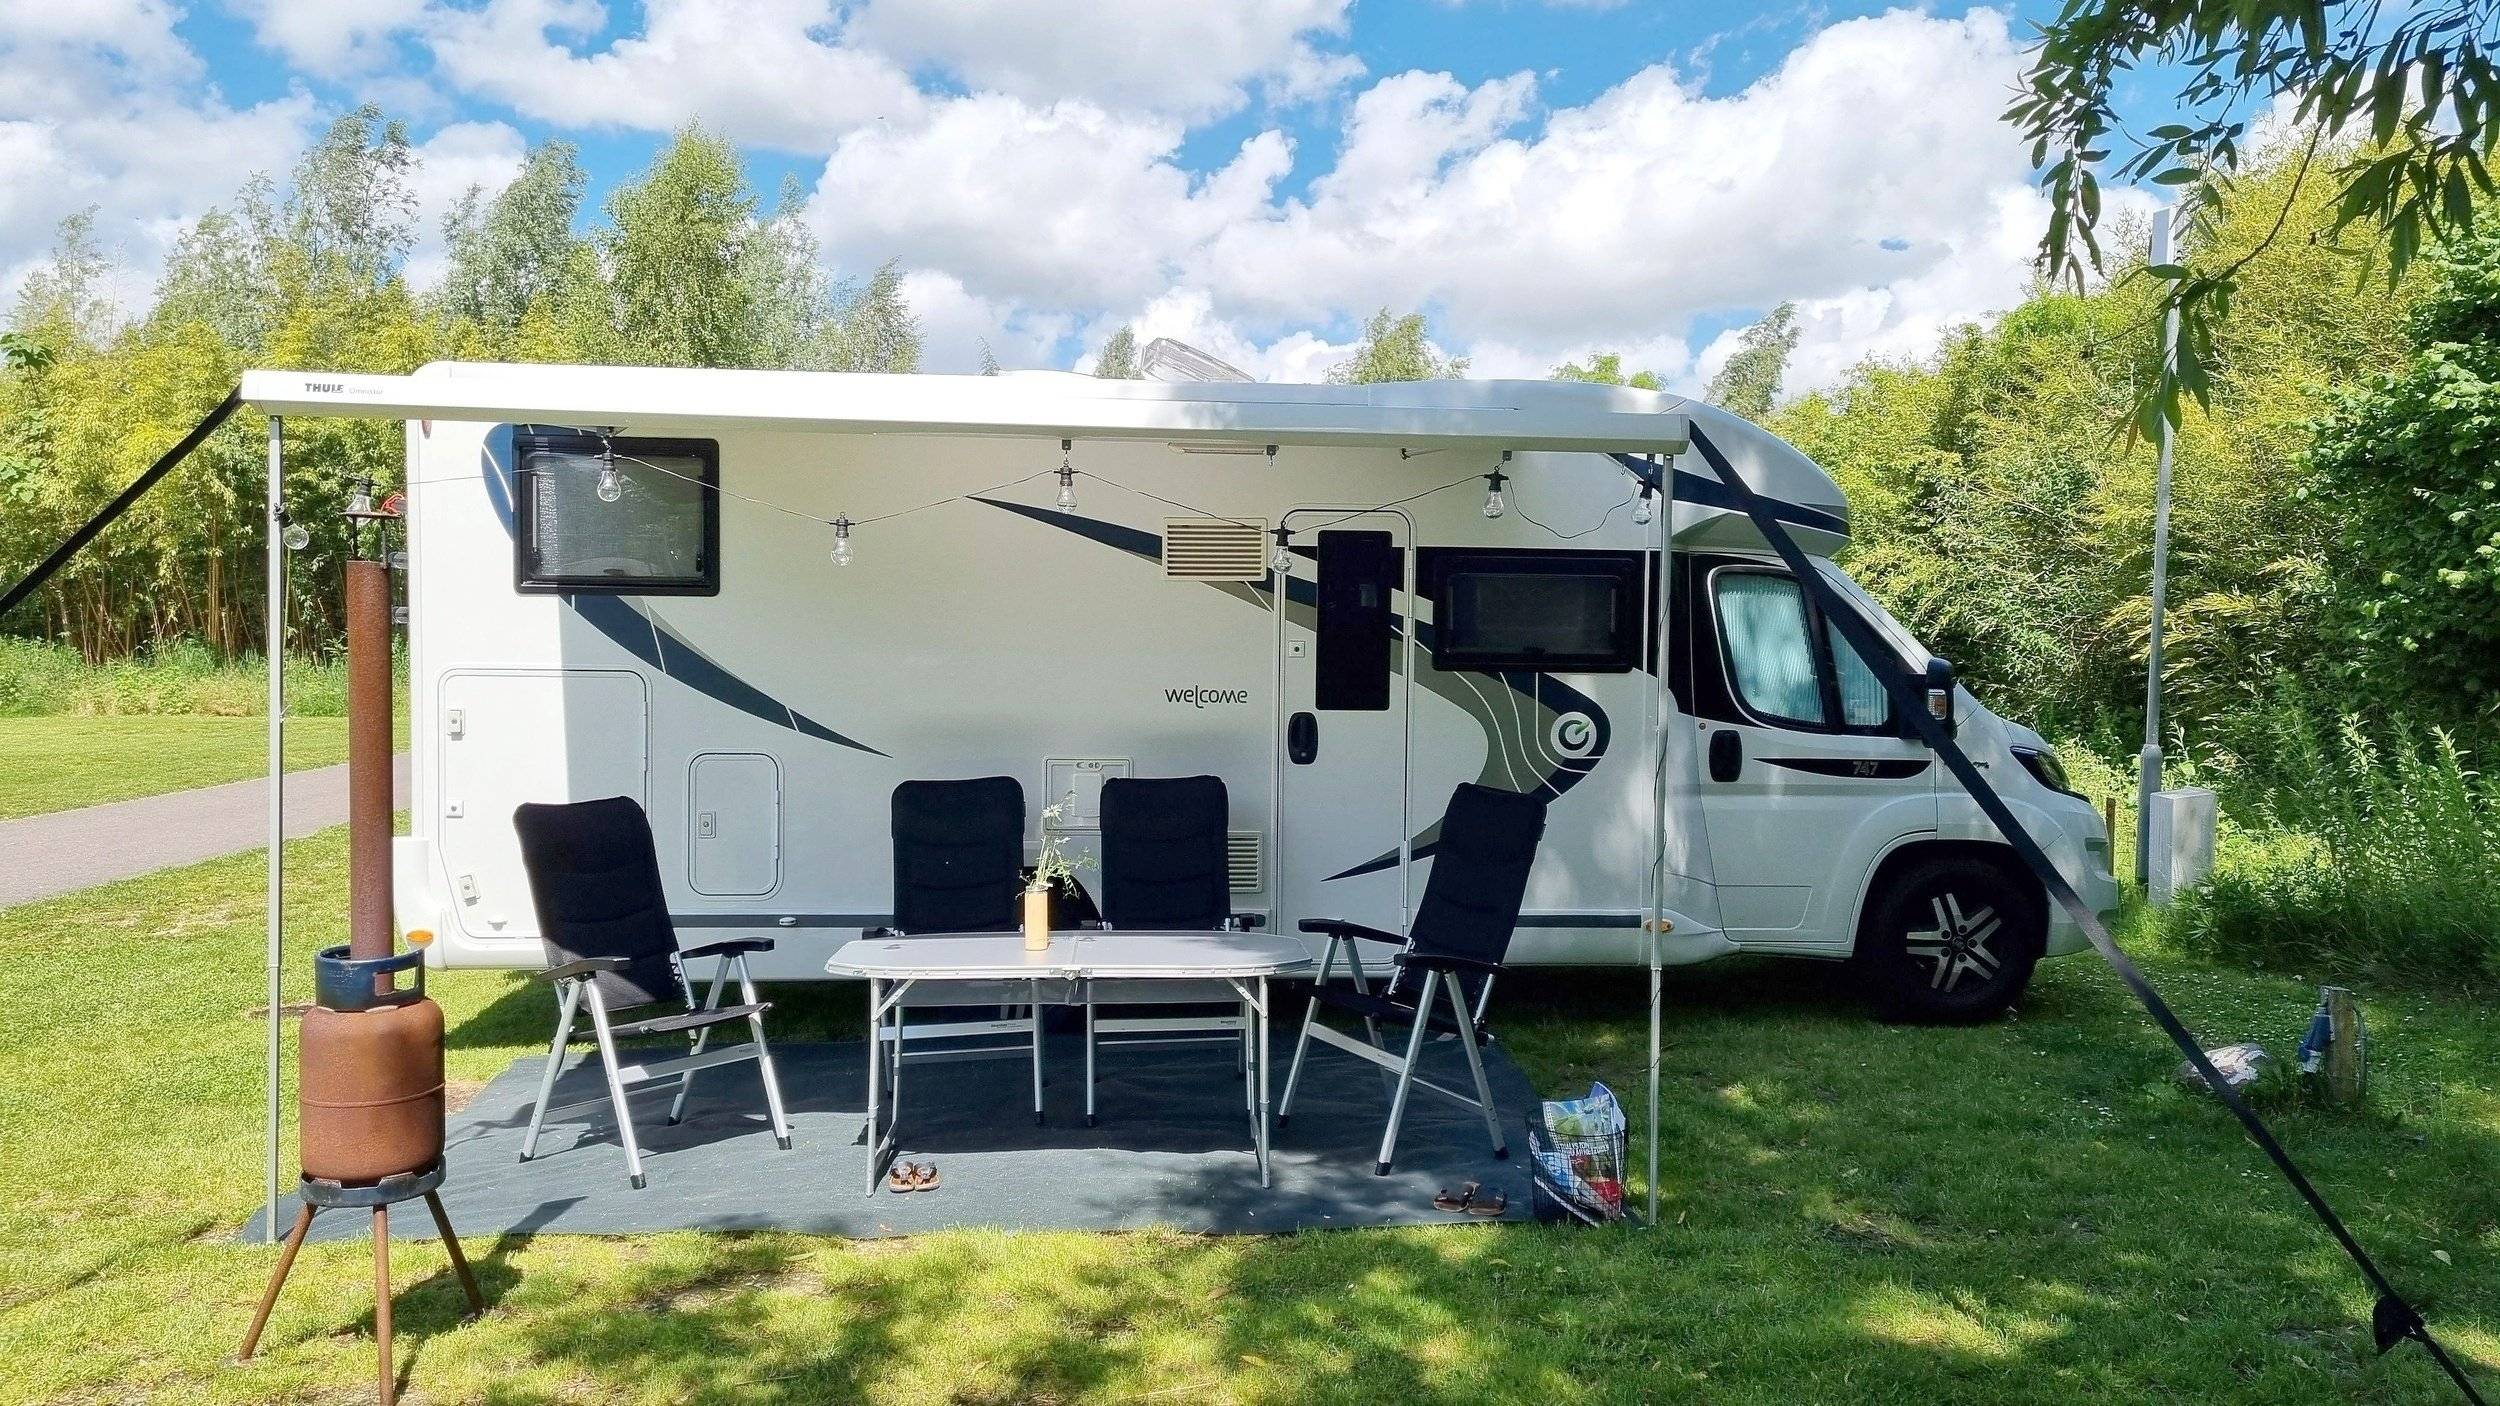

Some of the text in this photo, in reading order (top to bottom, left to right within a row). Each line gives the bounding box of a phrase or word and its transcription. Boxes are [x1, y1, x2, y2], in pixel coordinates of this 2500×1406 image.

[305, 383, 344, 394] THULE
[1164, 685, 1248, 709] welcome
[1852, 761, 1879, 776] 747
